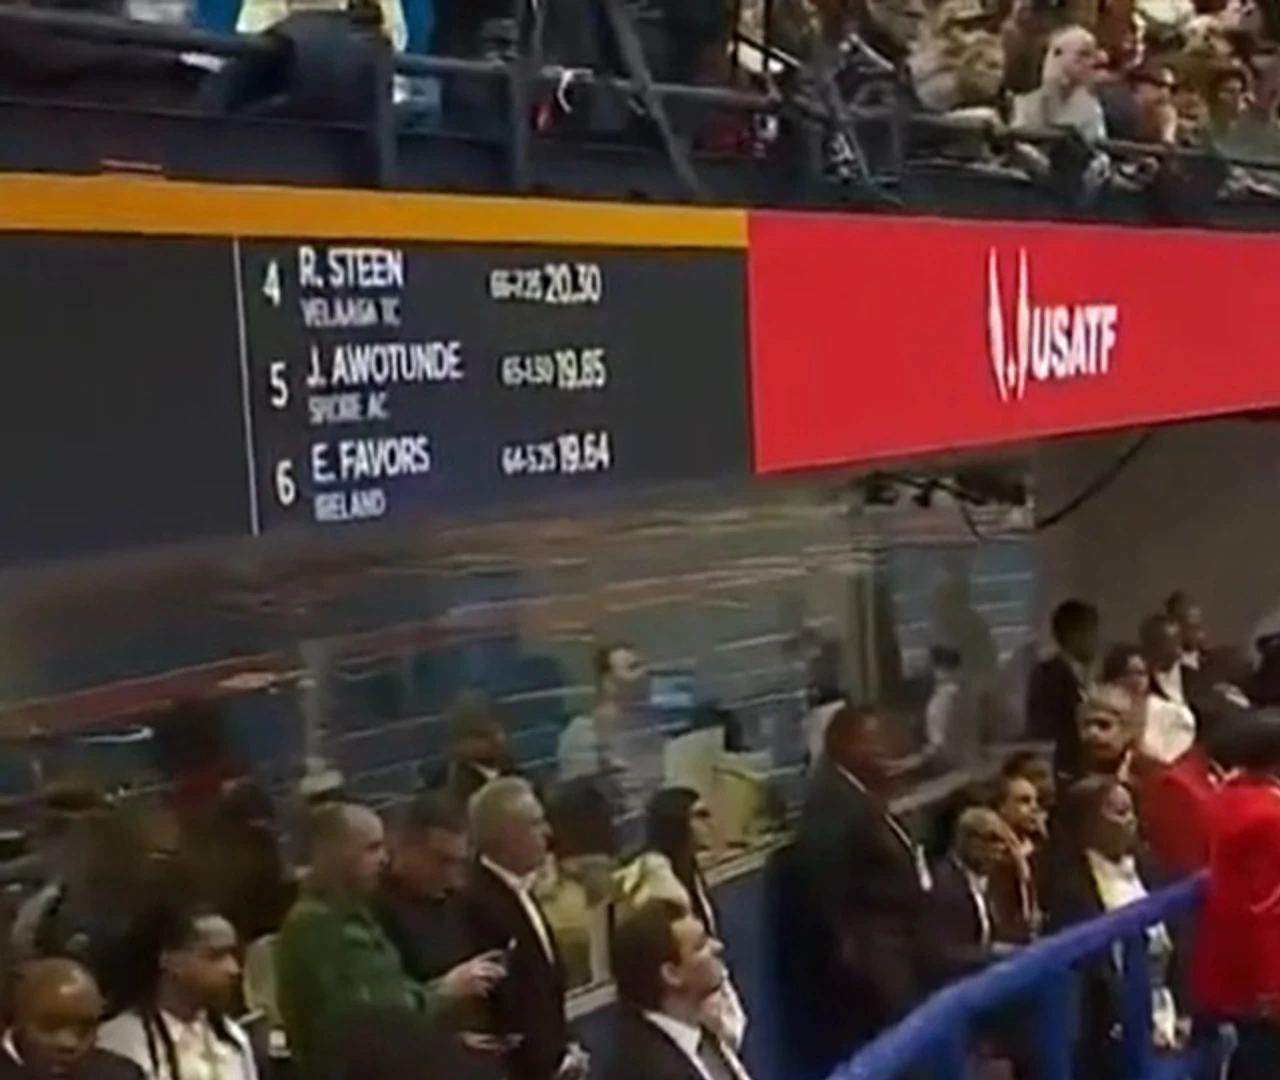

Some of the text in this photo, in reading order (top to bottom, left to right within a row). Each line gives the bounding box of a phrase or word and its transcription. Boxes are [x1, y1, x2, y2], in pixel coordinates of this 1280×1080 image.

[262, 259, 281, 307] 4
[299, 246, 324, 287] R.
[328, 246, 404, 288] STEEN
[270, 360, 288, 407] 5
[331, 340, 464, 386] AWOTUNDE
[1032, 304, 1118, 380] USATF
[366, 391, 390, 420] AC
[276, 459, 296, 506] 6
[339, 434, 430, 482] FAVORS
[315, 487, 386, 522] IRELAND
